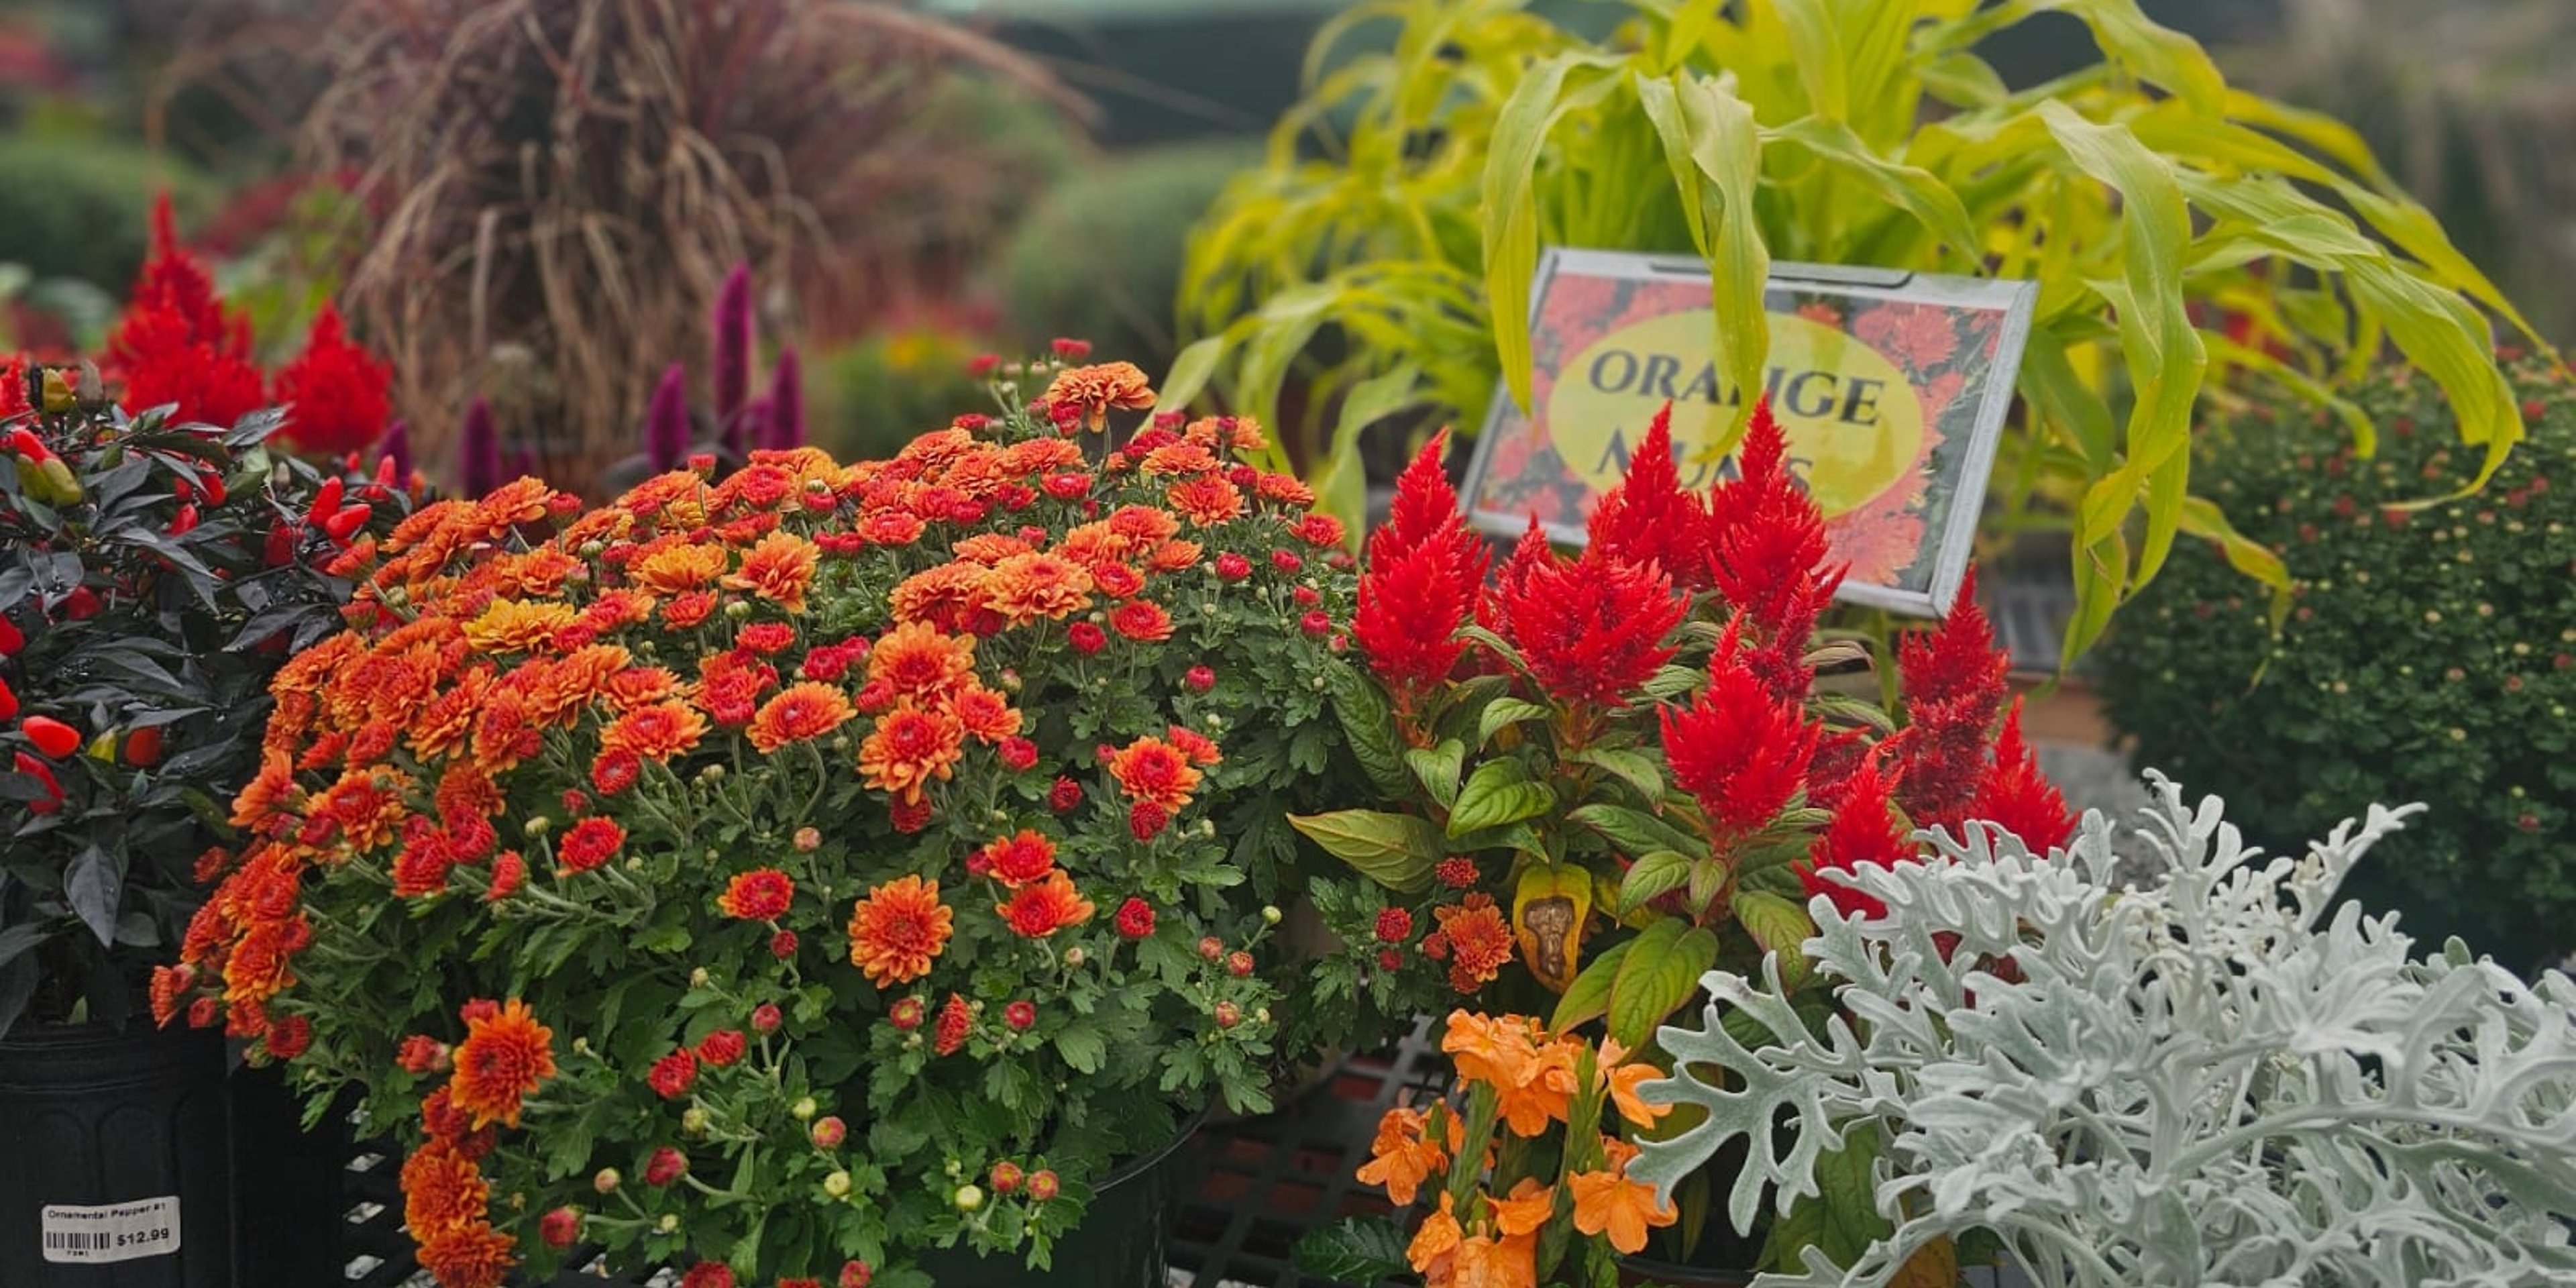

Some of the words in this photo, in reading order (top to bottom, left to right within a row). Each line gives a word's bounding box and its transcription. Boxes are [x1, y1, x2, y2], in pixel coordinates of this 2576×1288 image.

[48, 1210, 107, 1220] Ornamental
[111, 1205, 150, 1218] Pepper
[117, 1228, 170, 1246] $12.99
